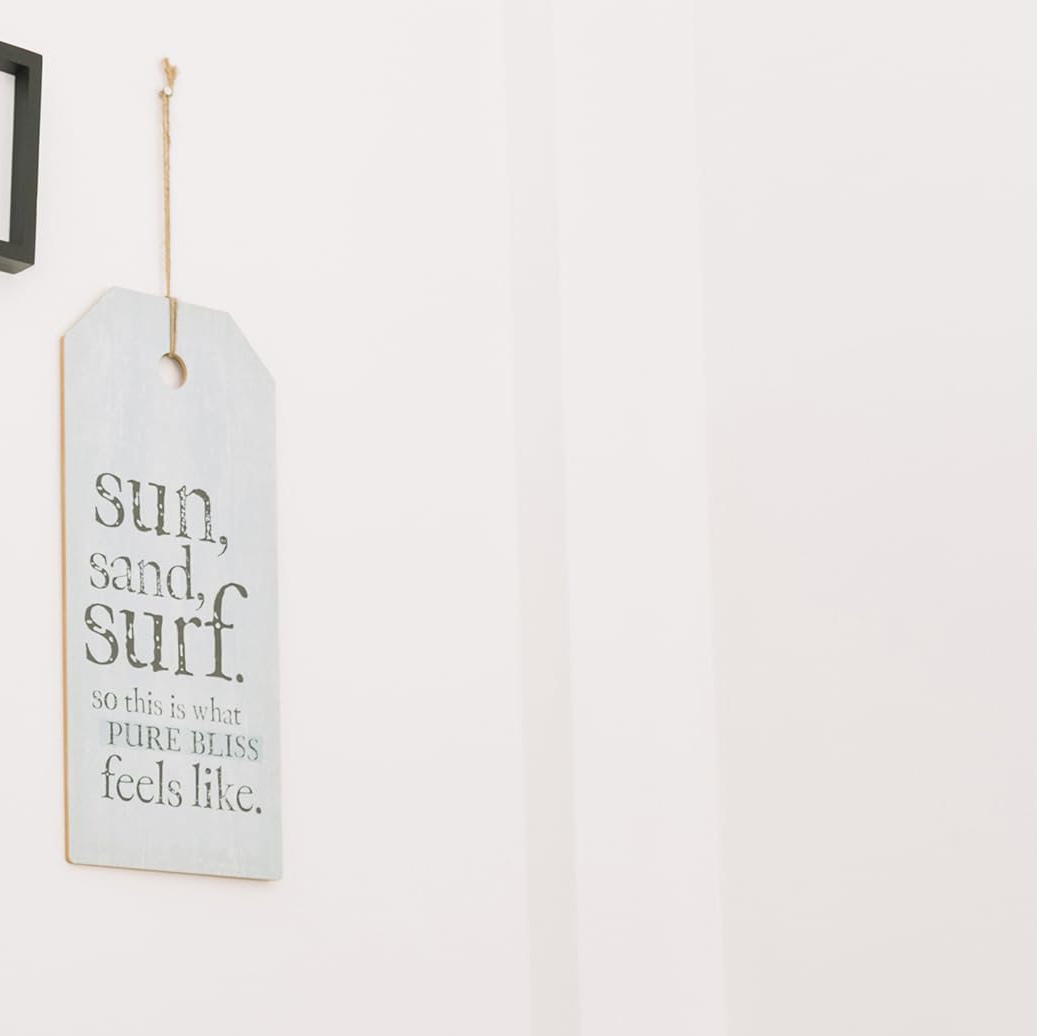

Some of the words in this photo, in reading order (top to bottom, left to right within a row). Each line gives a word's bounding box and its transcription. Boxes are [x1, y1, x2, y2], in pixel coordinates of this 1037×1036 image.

[94, 472, 229, 557] sun,
[89, 544, 207, 611] sand,
[83, 582, 249, 684] surf.
[91, 688, 119, 711] so
[124, 687, 164, 718] this
[170, 694, 187, 720] is
[191, 696, 241, 727] what
[106, 720, 182, 753] PURE
[190, 730, 260, 762] BLISS
[100, 754, 183, 808] feels
[191, 762, 263, 815] like.
